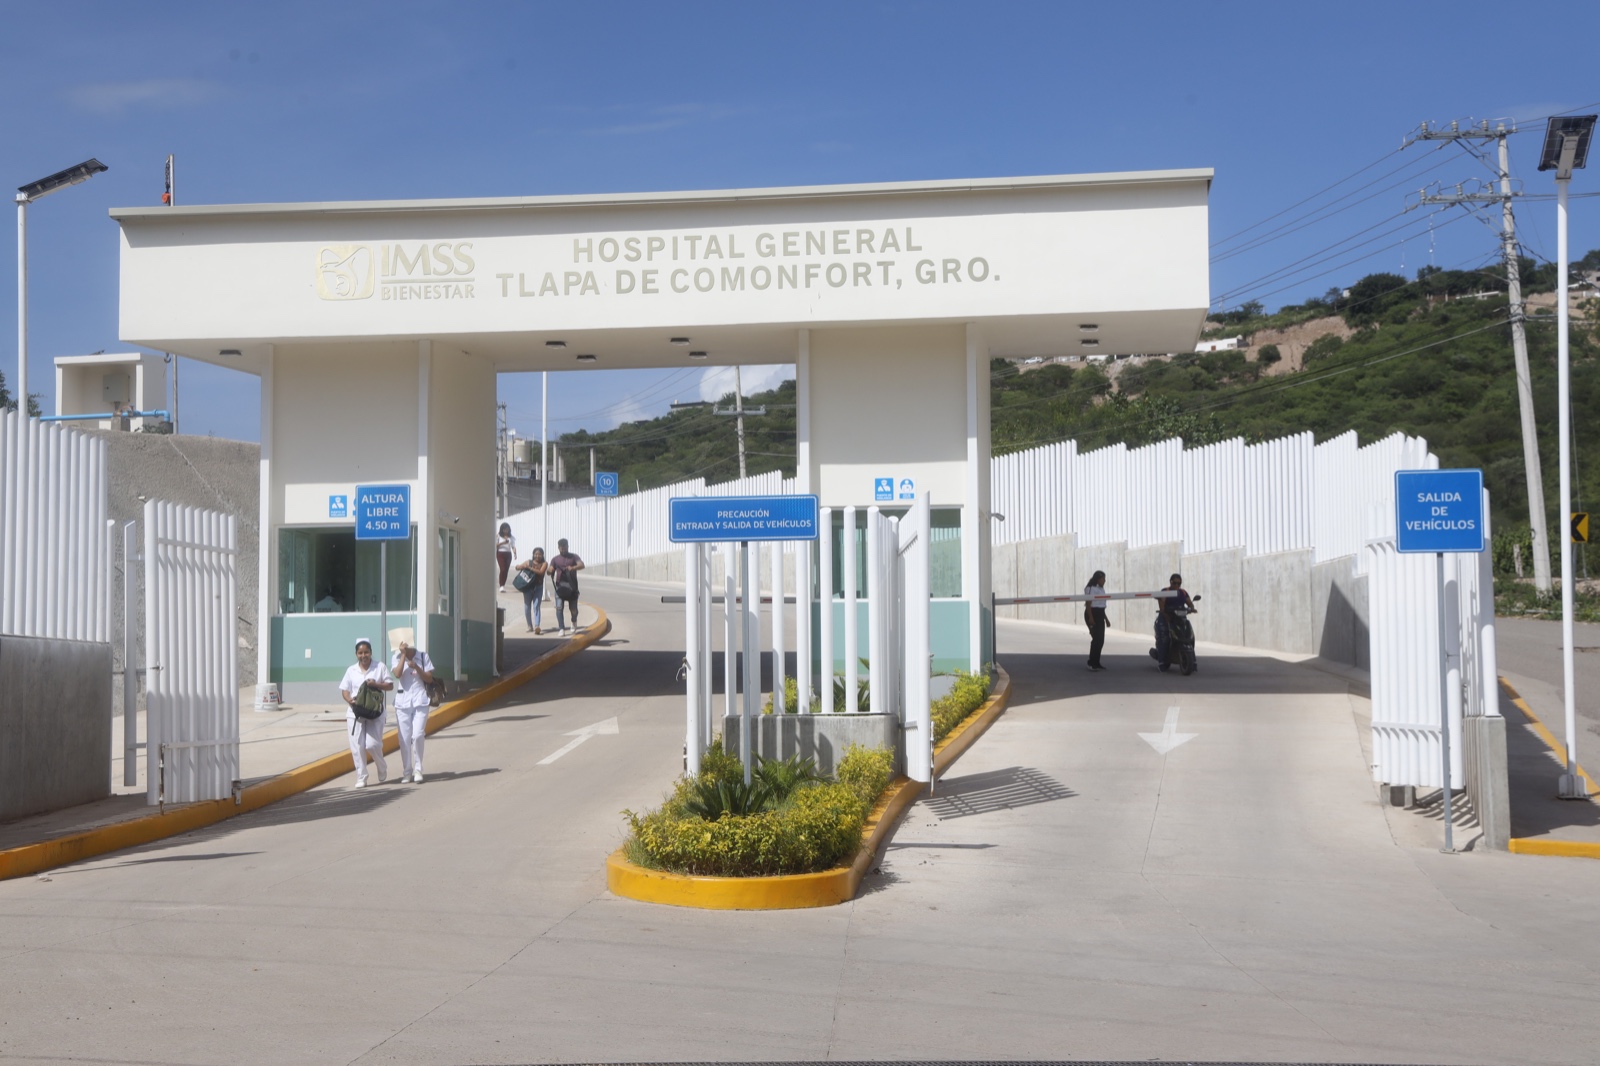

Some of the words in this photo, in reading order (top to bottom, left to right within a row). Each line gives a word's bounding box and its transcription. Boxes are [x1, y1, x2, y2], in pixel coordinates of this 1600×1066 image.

[573, 234, 745, 263] HOSPITAL
[755, 227, 922, 258] GENERAL
[381, 242, 475, 277] IMSS
[496, 271, 600, 297] TLAPA
[615, 269, 659, 294] DE
[670, 261, 902, 293] COMONFORT,
[915, 257, 1000, 285] GRO.
[381, 284, 475, 300] BIENESTAR
[602, 478, 612, 486] 10
[361, 493, 404, 504] ALTURA
[1417, 492, 1462, 503] SALIDA
[366, 507, 399, 517] LIBRE
[717, 508, 770, 519] PRECAUCIÓN
[1431, 506, 1448, 516] DE
[365, 521, 388, 530] 4.50
[390, 522, 400, 530] m
[676, 522, 714, 530] ENTRADA
[715, 521, 720, 529] Y
[722, 520, 751, 529] SALIDA
[753, 520, 765, 528] DE
[766, 518, 812, 528] VEHÍCULOS
[1405, 518, 1475, 531] VEHÍCULOS
